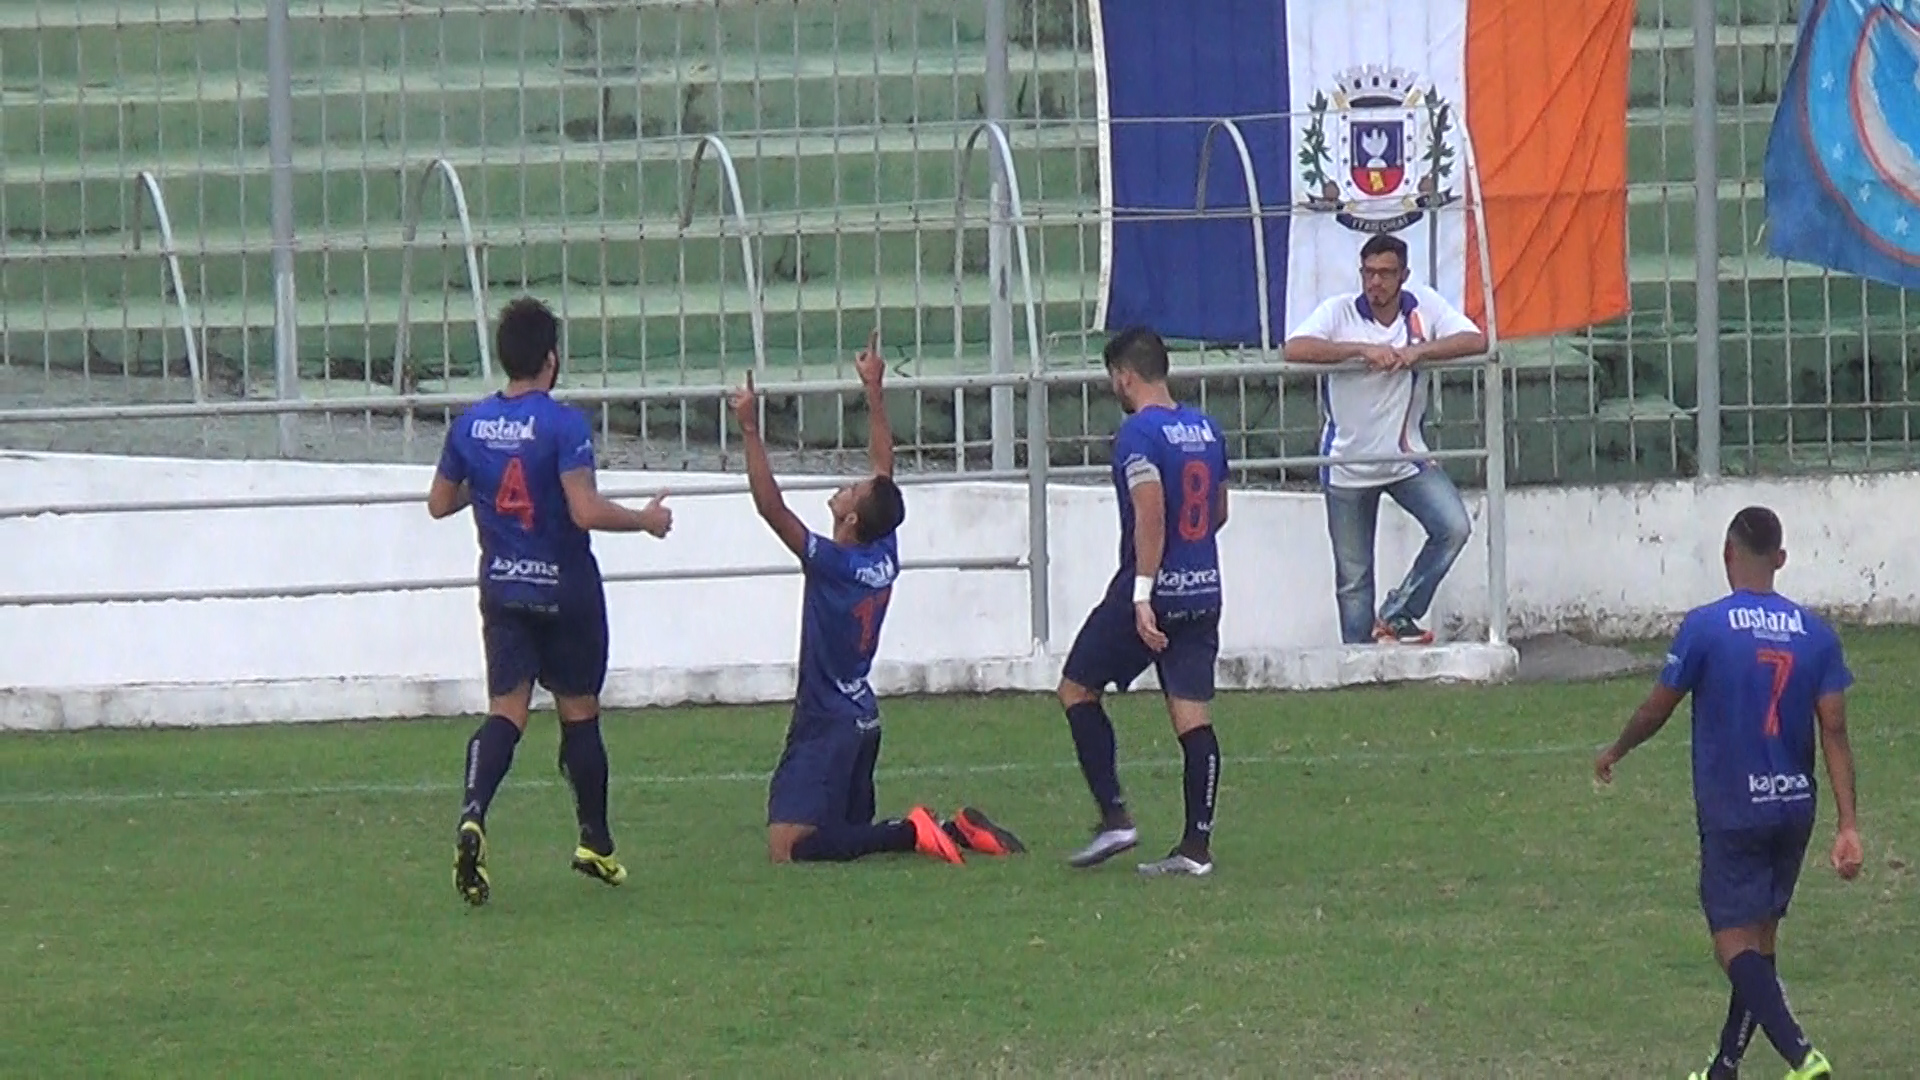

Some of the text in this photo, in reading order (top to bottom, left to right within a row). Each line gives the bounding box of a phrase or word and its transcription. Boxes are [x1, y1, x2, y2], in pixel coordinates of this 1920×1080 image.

[495, 456, 536, 531] 4
[1179, 459, 1211, 541] 8
[1757, 648, 1794, 737] 7
